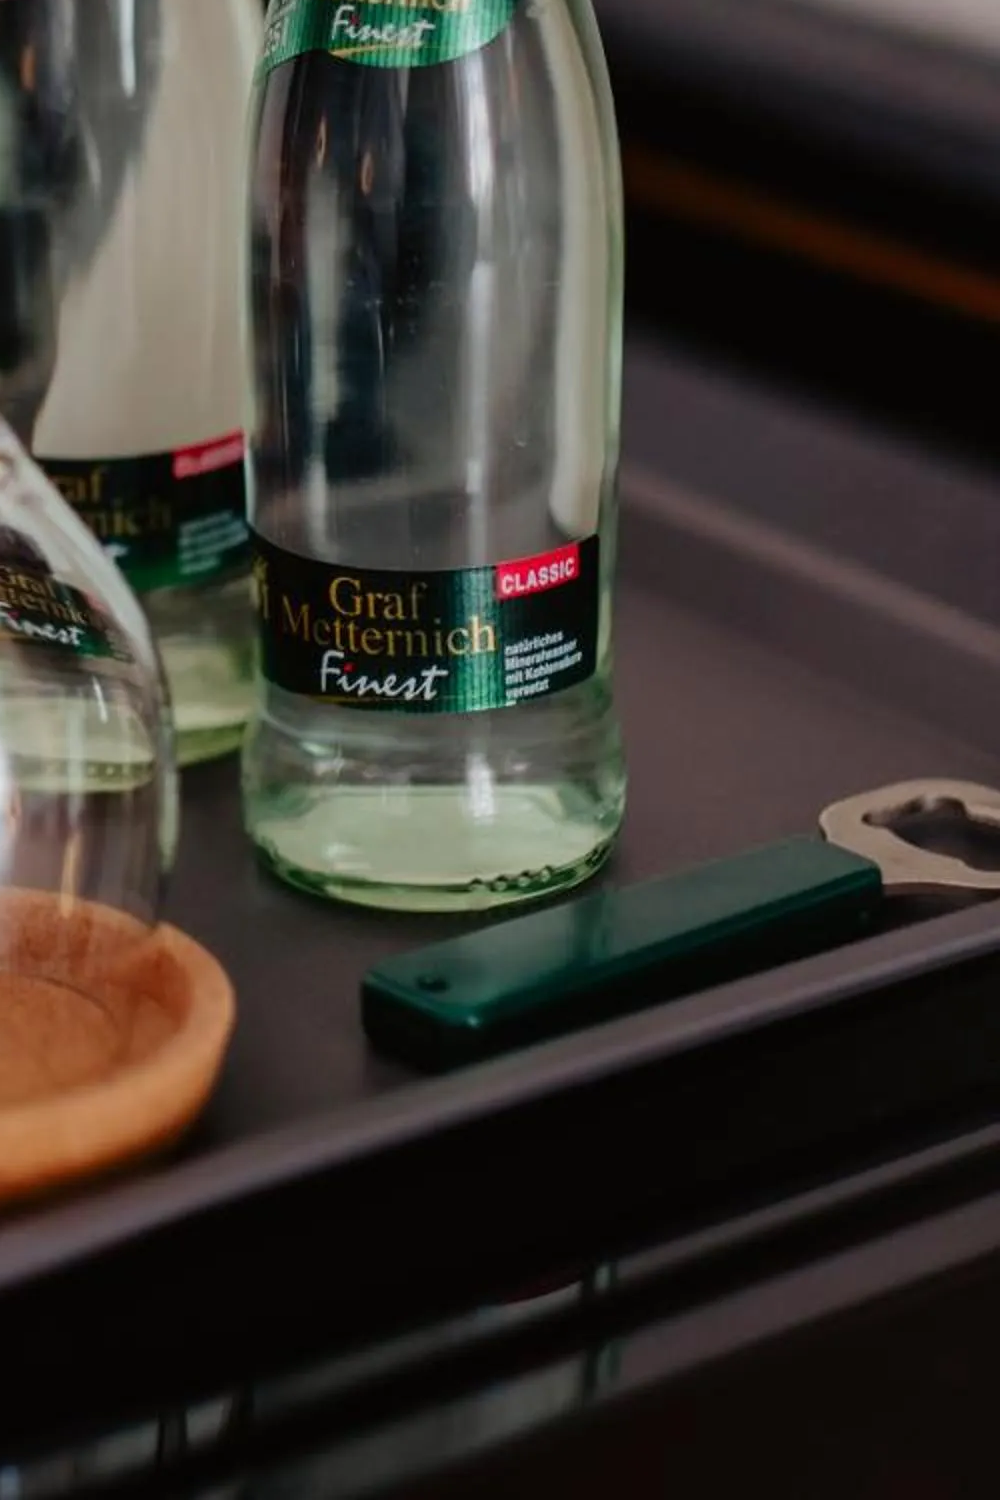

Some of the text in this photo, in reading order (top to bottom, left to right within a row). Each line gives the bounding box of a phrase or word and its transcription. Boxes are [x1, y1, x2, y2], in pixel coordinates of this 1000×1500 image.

[330, 5, 436, 49] Finest
[328, 576, 428, 621] Graf
[500, 557, 576, 596] CLASSIC
[281, 594, 496, 658] Metternich
[319, 649, 449, 701] Finest
